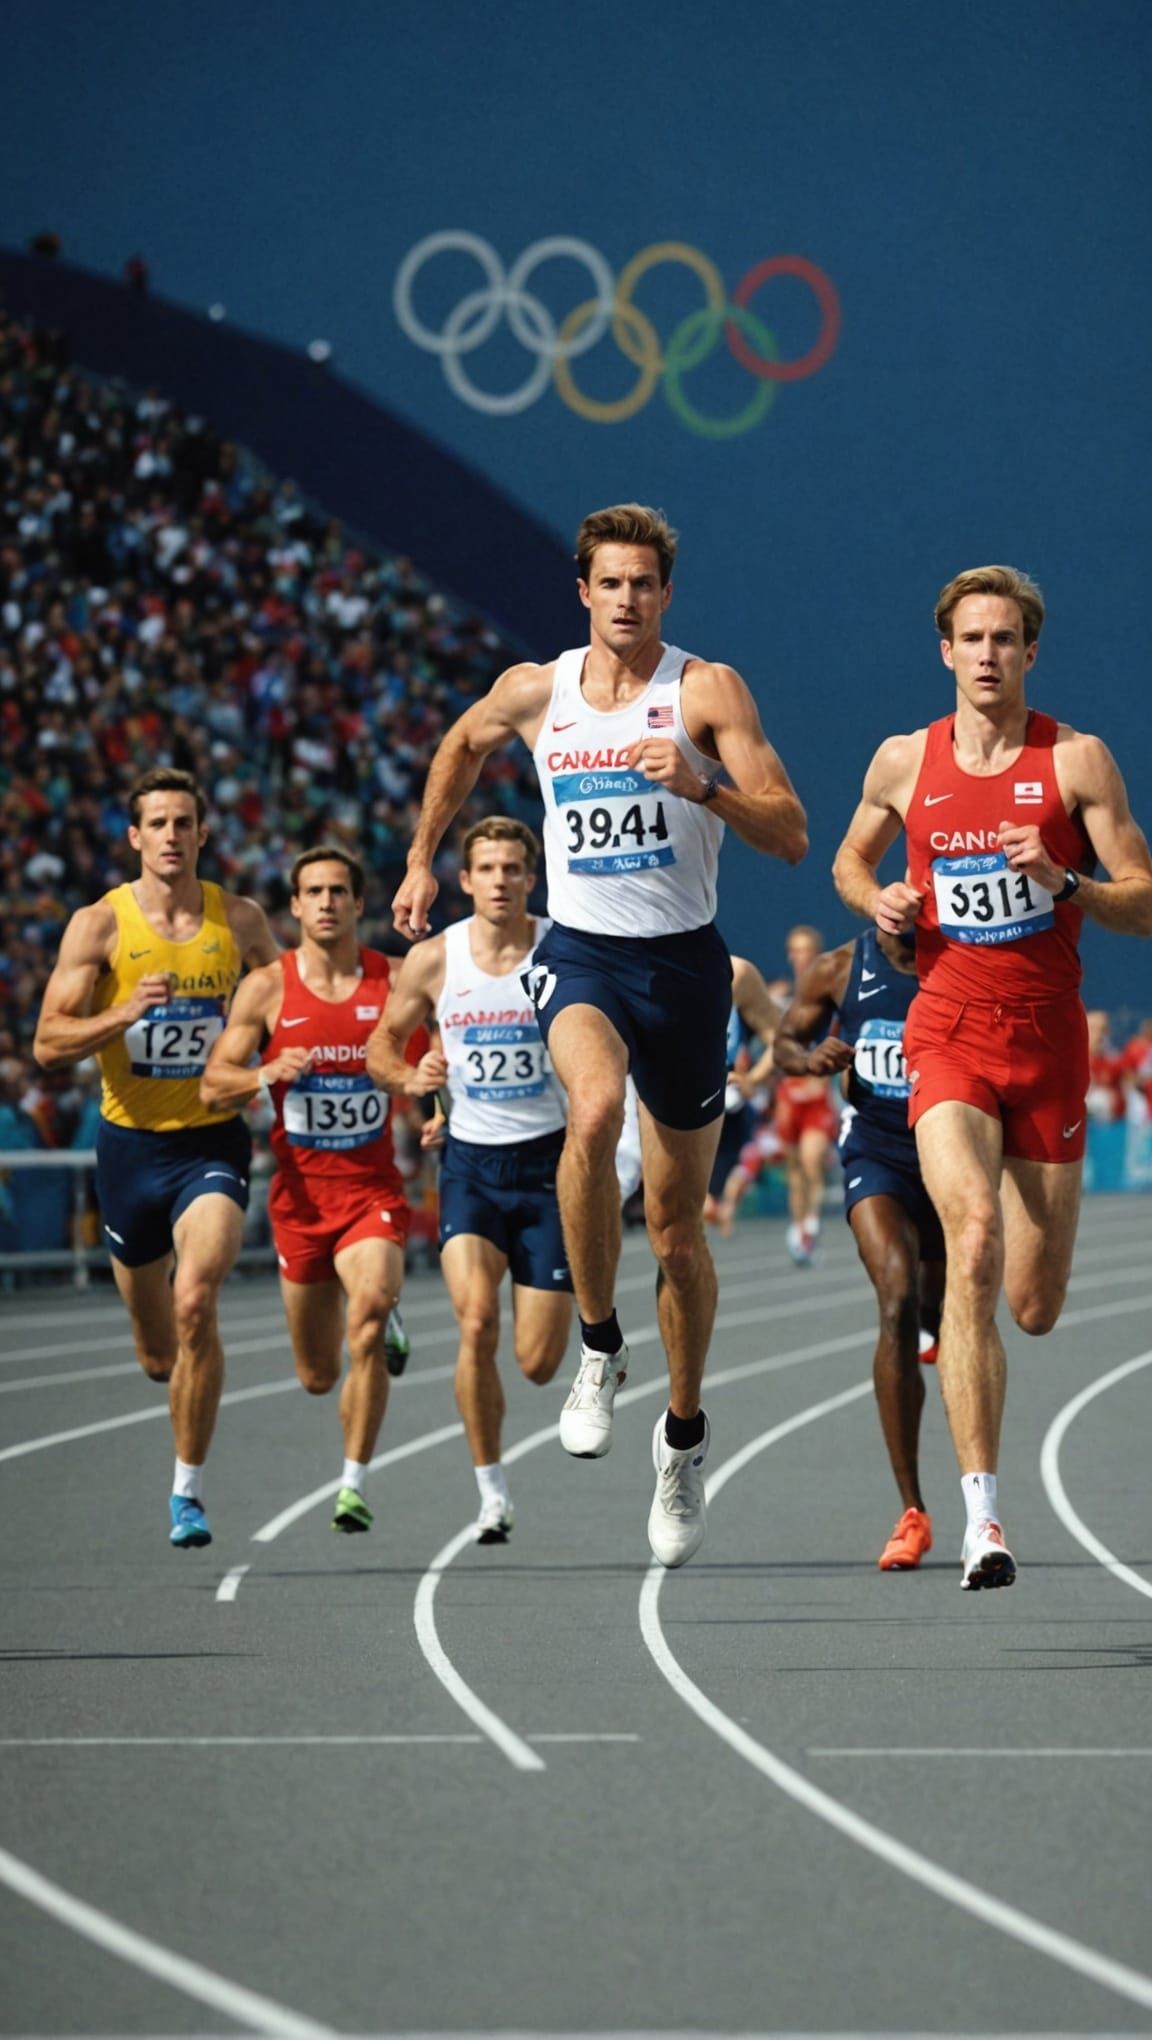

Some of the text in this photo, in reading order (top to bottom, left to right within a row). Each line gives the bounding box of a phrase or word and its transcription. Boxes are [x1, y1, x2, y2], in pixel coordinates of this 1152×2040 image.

[142, 1022, 208, 1059] 125
[467, 1050, 534, 1082] 323
[304, 1094, 381, 1132] 1350
